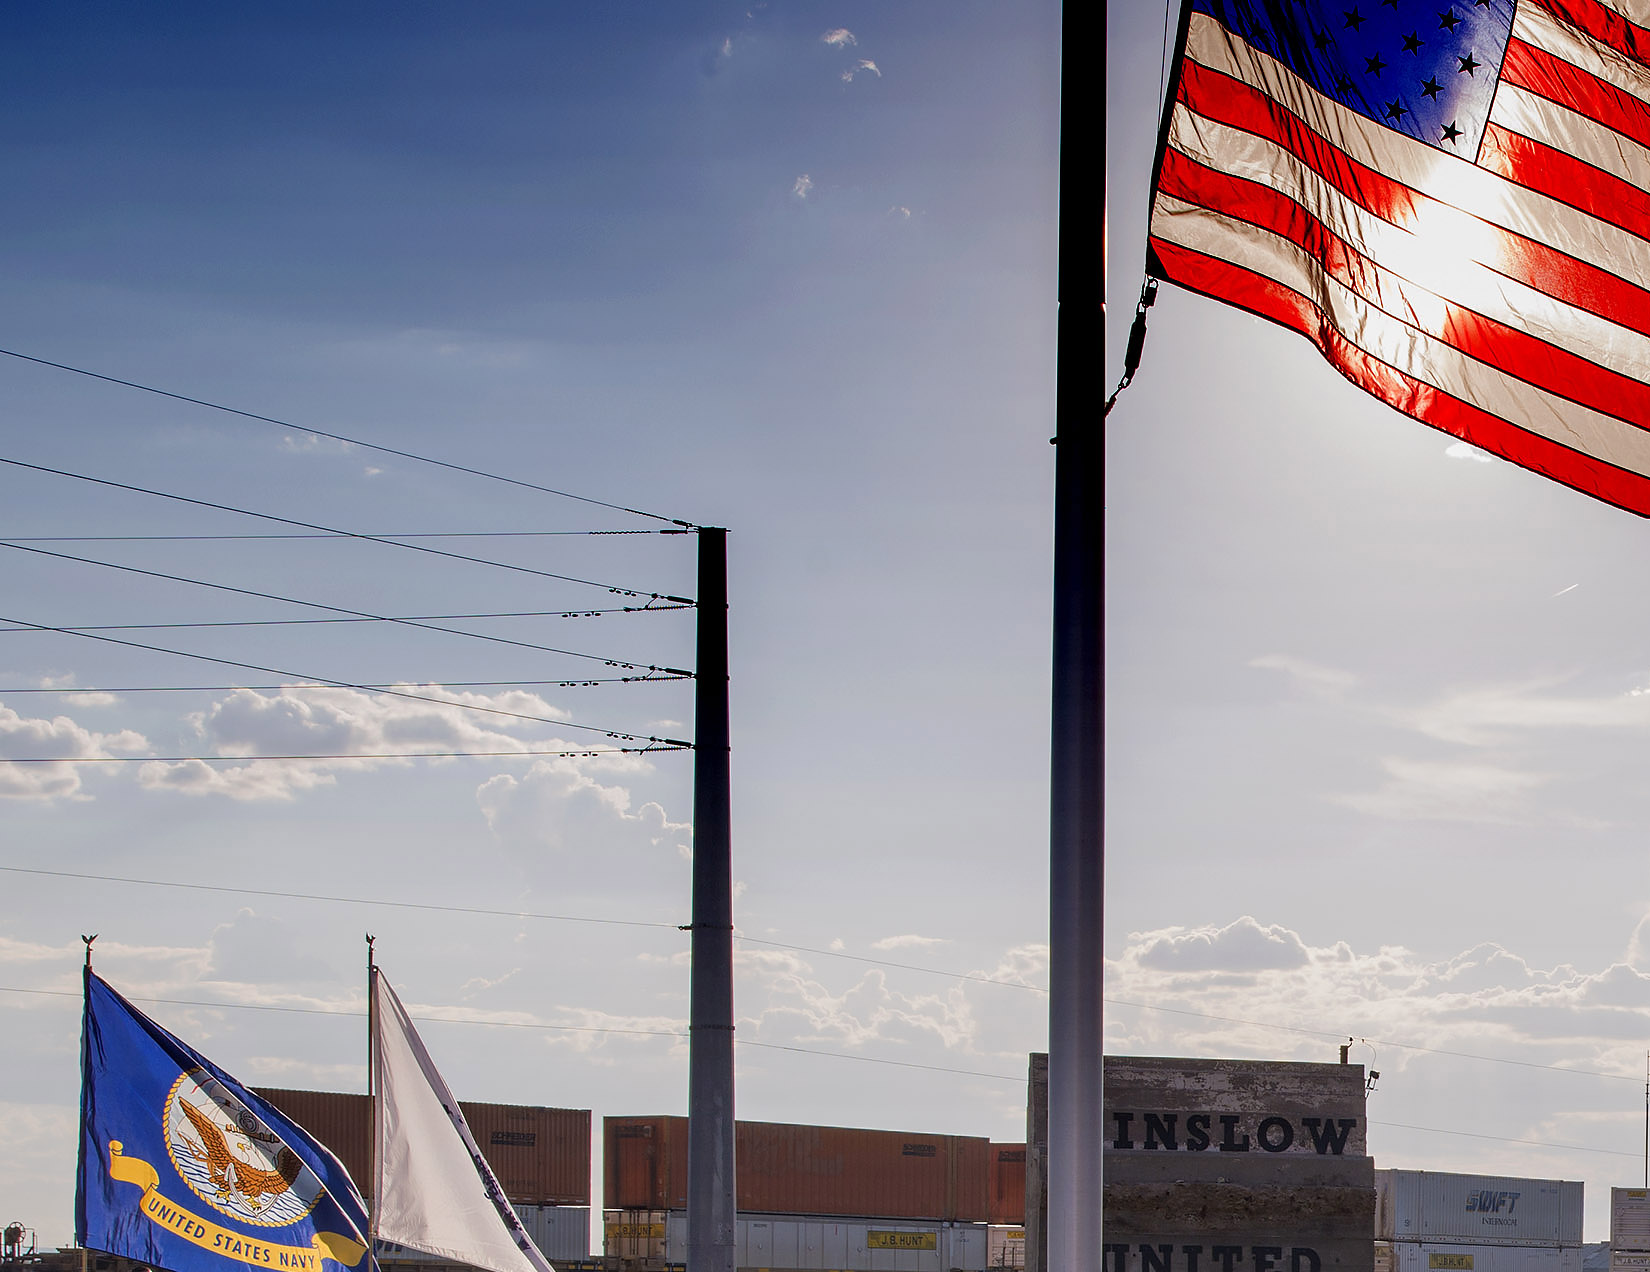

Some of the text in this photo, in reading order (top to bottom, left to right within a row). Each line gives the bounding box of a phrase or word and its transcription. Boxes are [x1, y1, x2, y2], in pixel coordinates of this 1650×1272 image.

[1113, 1112, 1357, 1155] INSLOW
[1465, 1190, 1521, 1214] SWIFT
[148, 1197, 316, 1269] UNITED STATES NAVY
[881, 1233, 923, 1246] J.B. HUNT
